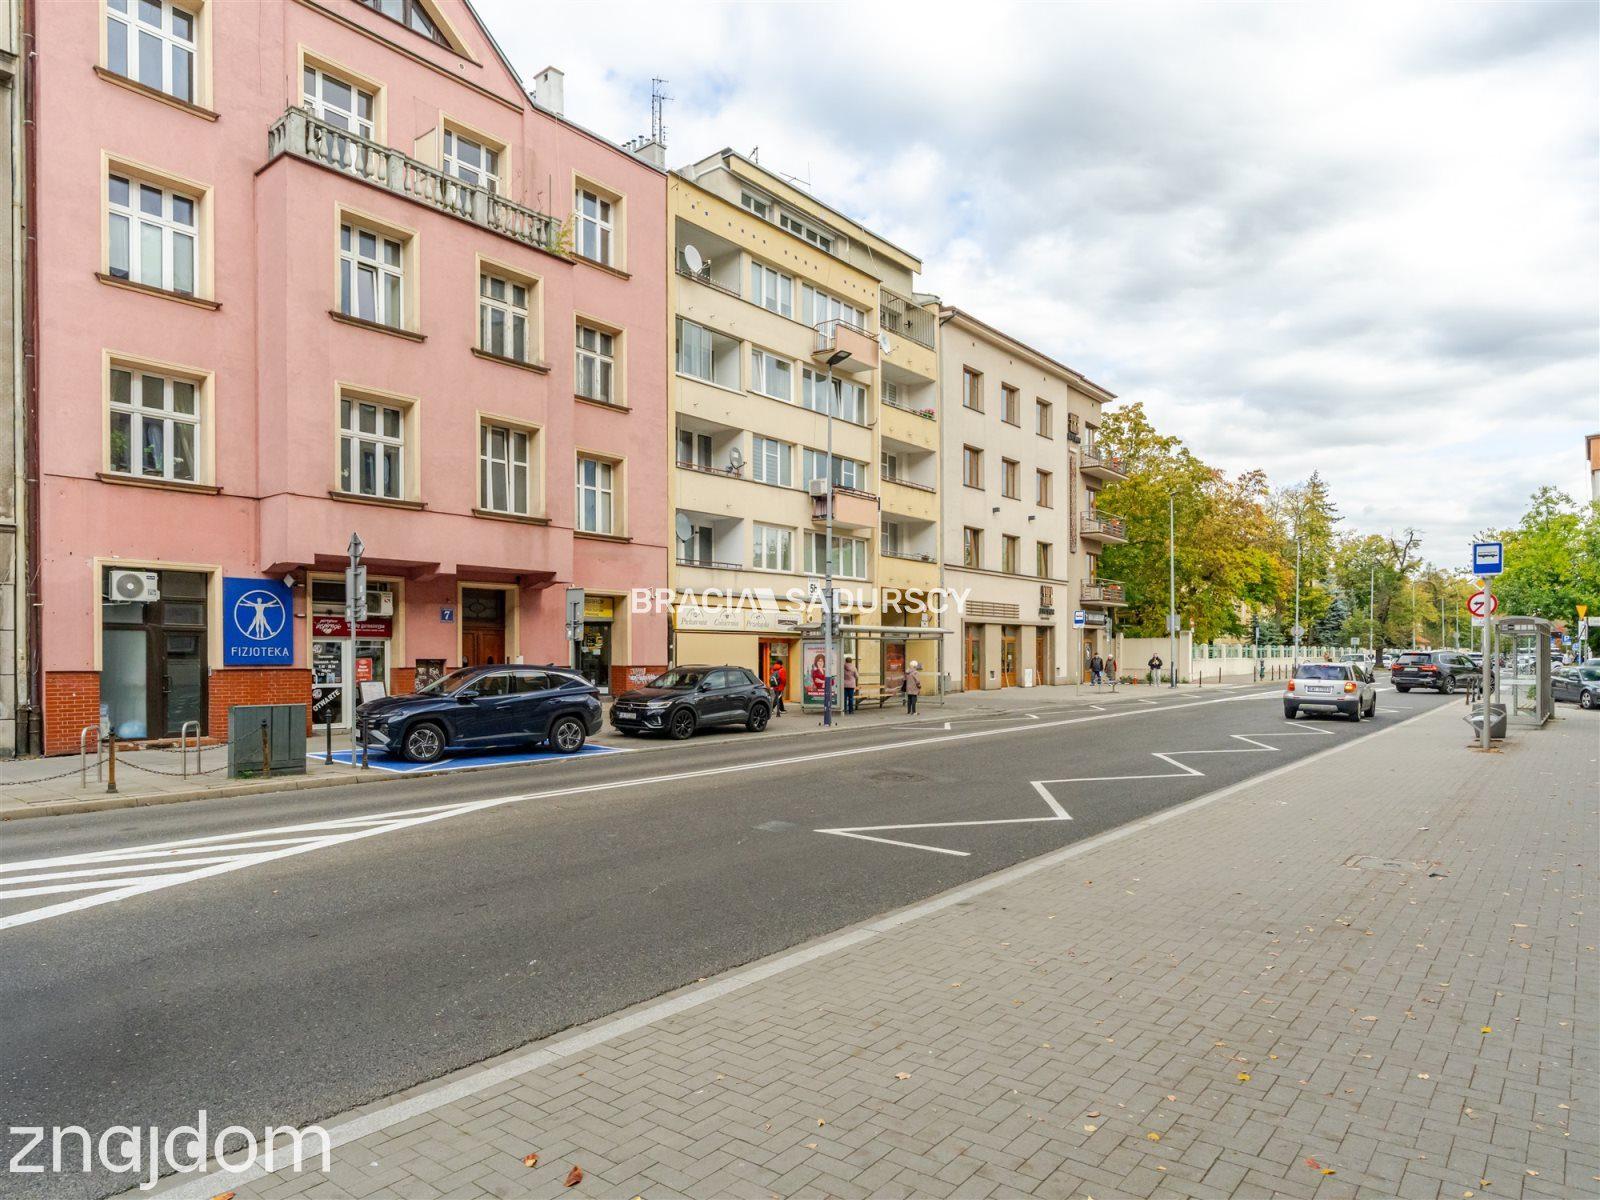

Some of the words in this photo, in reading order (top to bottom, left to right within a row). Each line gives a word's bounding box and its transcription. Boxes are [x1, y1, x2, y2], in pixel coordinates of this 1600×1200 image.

[443, 610, 451, 620] 7
[231, 646, 290, 657] FIZJOTEKA
[312, 689, 341, 712] OTWARTE
